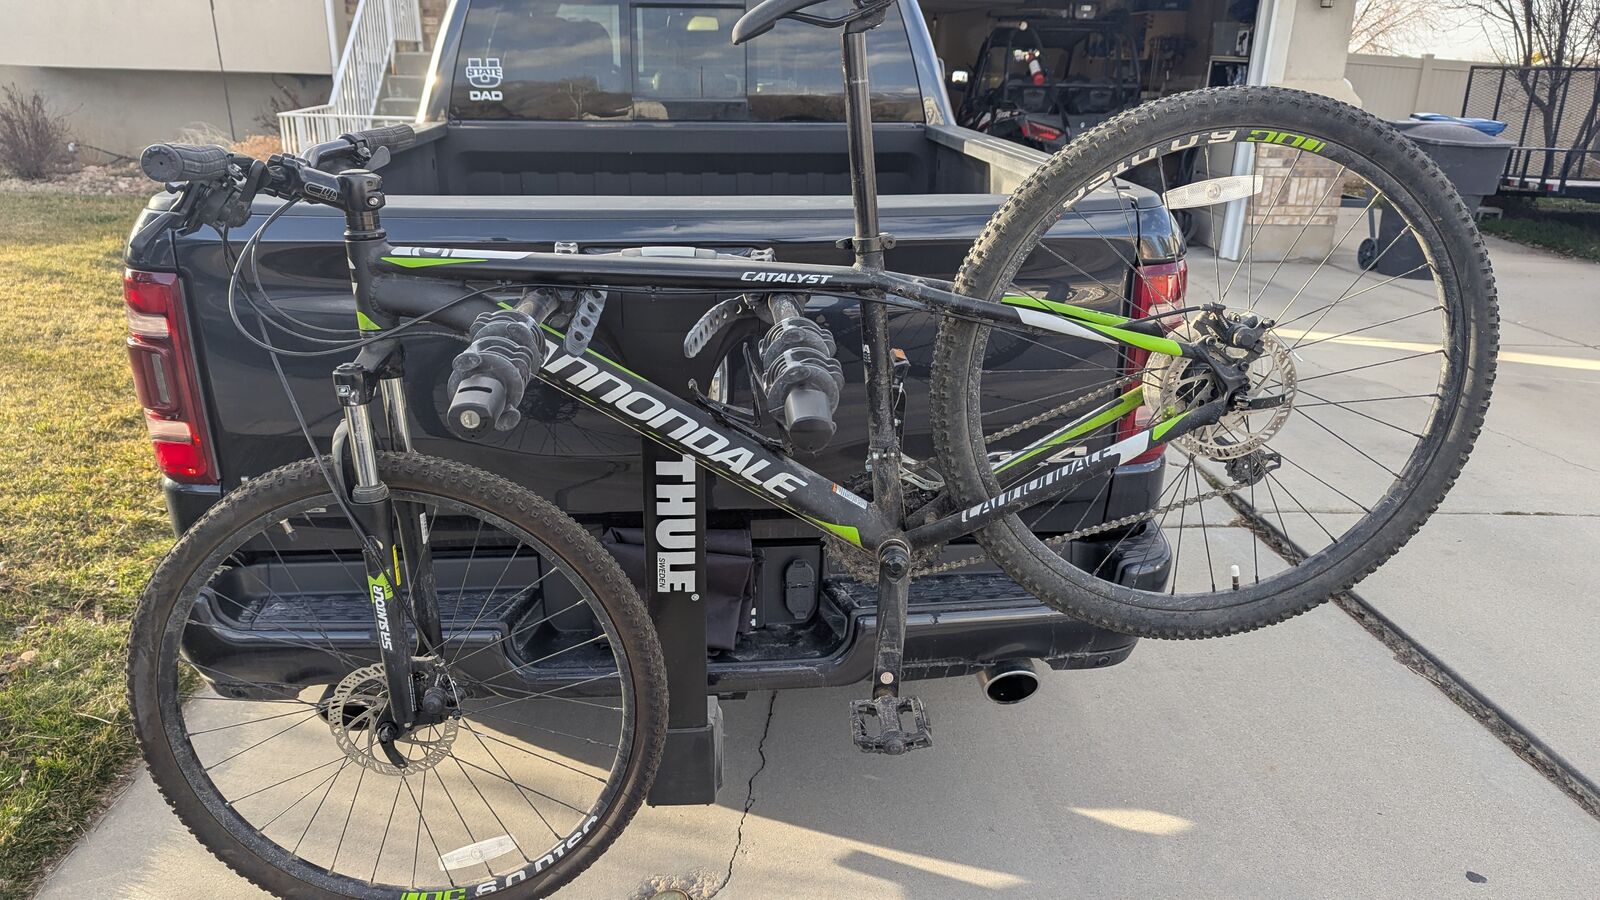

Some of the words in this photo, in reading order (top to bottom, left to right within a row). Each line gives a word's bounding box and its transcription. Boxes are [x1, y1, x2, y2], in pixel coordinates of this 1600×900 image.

[466, 67, 503, 79] STATE
[469, 90, 503, 101] DAD
[740, 271, 833, 284] CATALYST
[655, 453, 696, 593] THULE
[658, 557, 666, 589] SWEDEN
[373, 585, 390, 632] SUNTOUR
